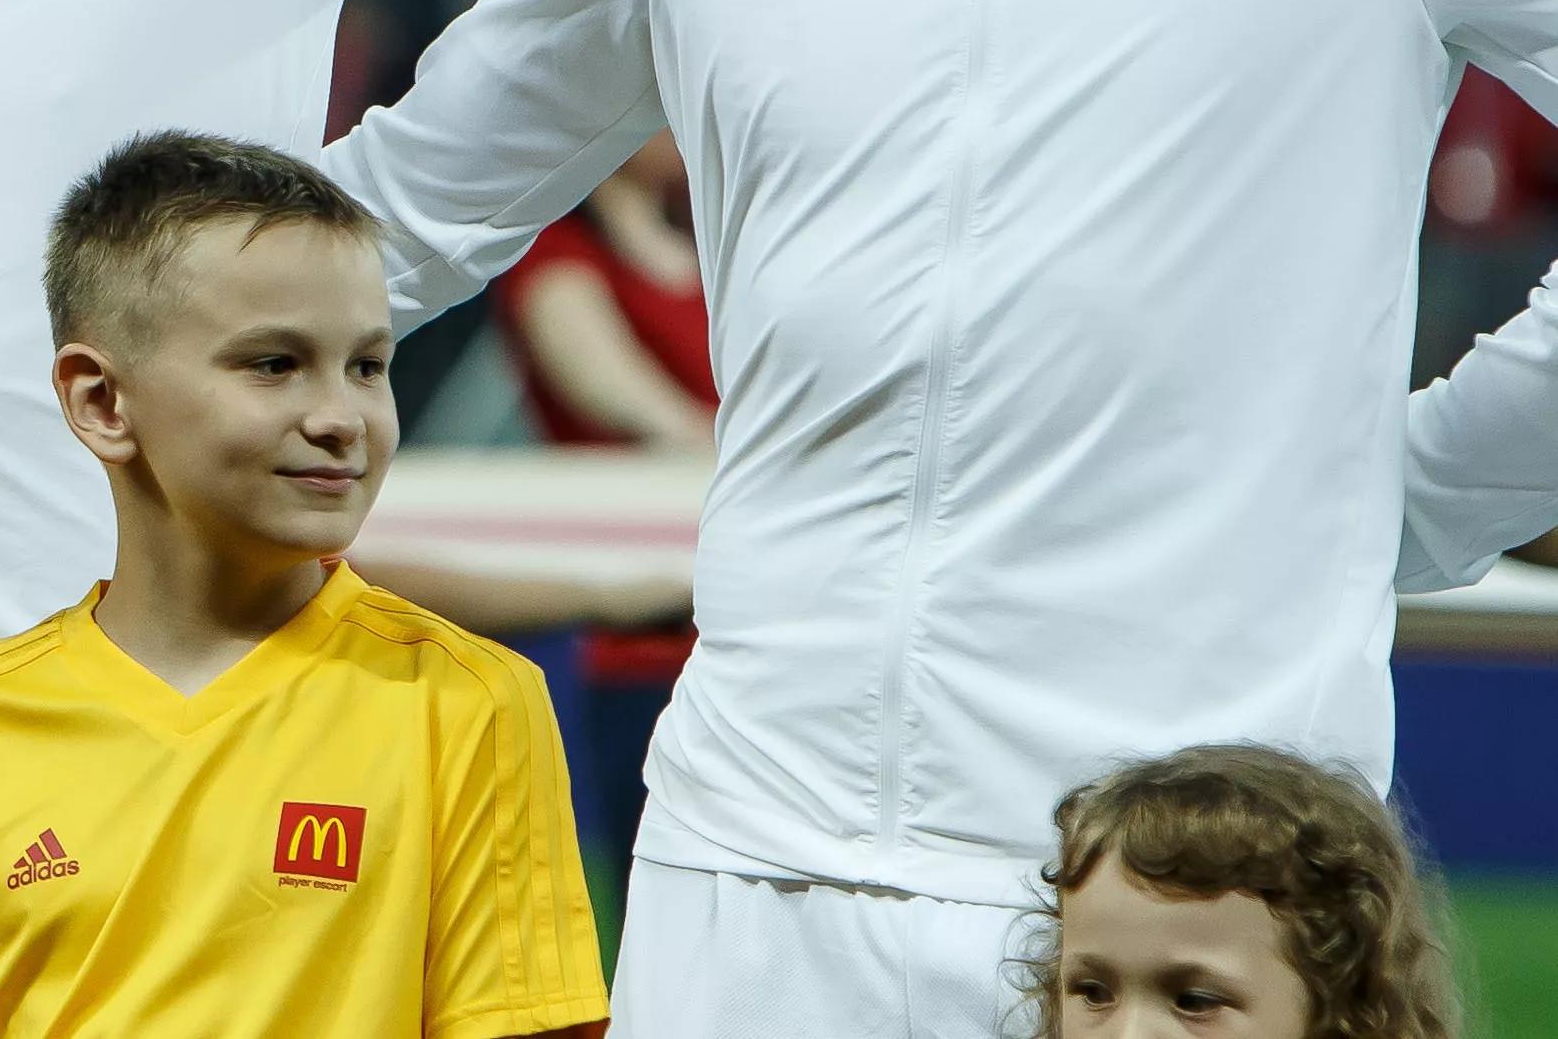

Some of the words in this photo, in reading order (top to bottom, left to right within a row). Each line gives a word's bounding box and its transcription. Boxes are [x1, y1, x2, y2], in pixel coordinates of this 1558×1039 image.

[6, 860, 81, 891] adidas
[278, 876, 312, 888] player
[313, 880, 347, 892] escort
